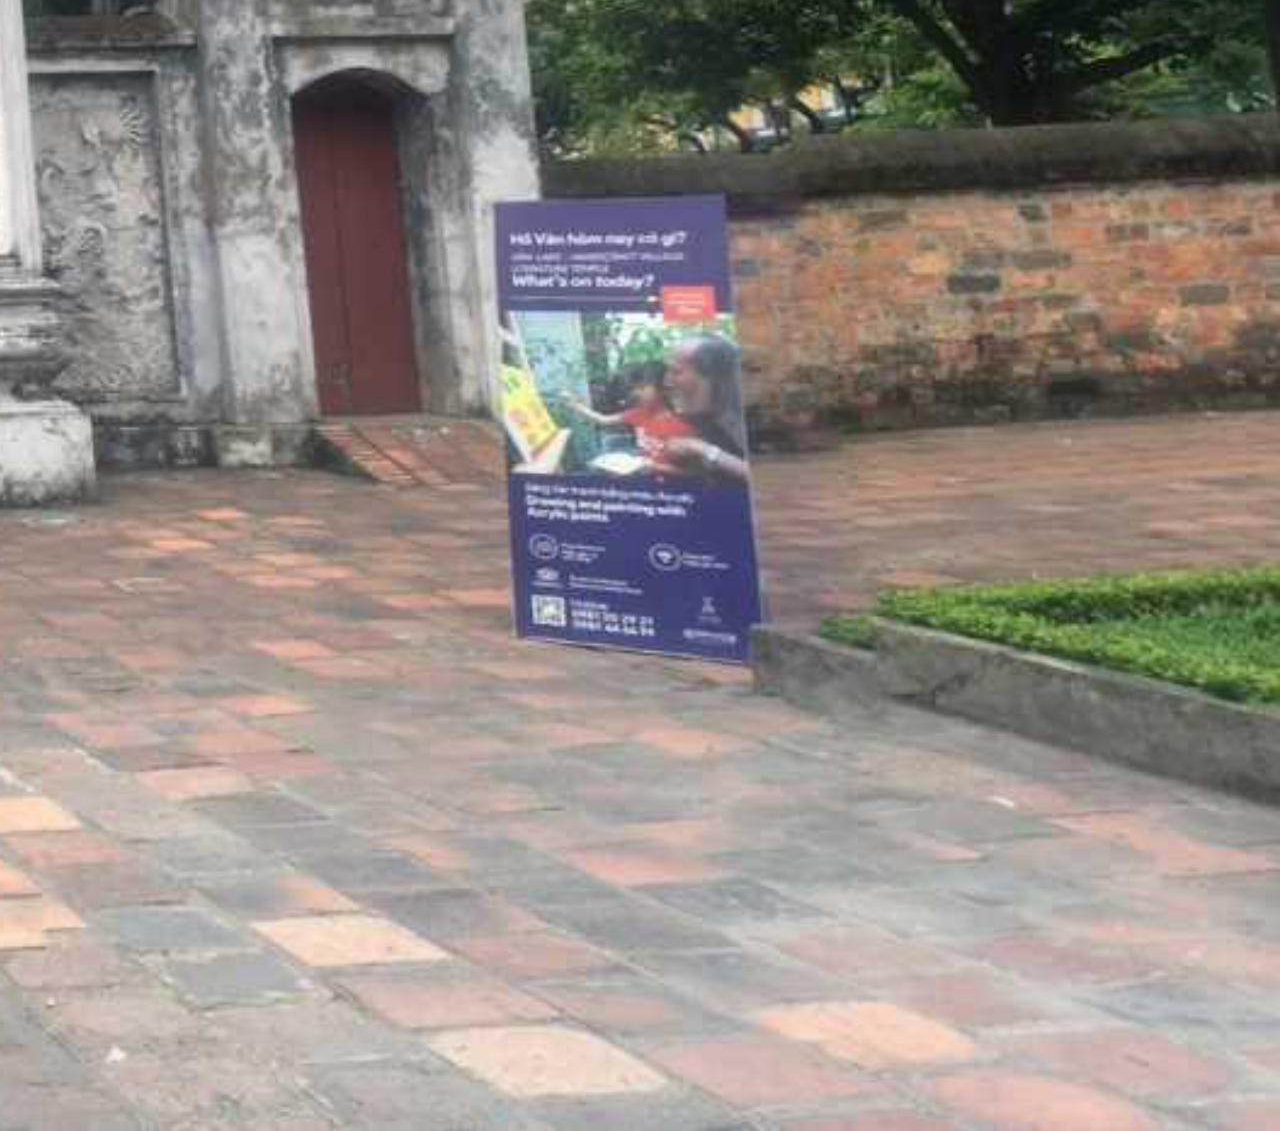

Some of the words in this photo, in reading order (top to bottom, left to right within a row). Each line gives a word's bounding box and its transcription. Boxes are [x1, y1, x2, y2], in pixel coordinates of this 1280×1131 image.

[512, 273, 567, 287] What's
[571, 276, 592, 287] on
[595, 273, 655, 290] today?
